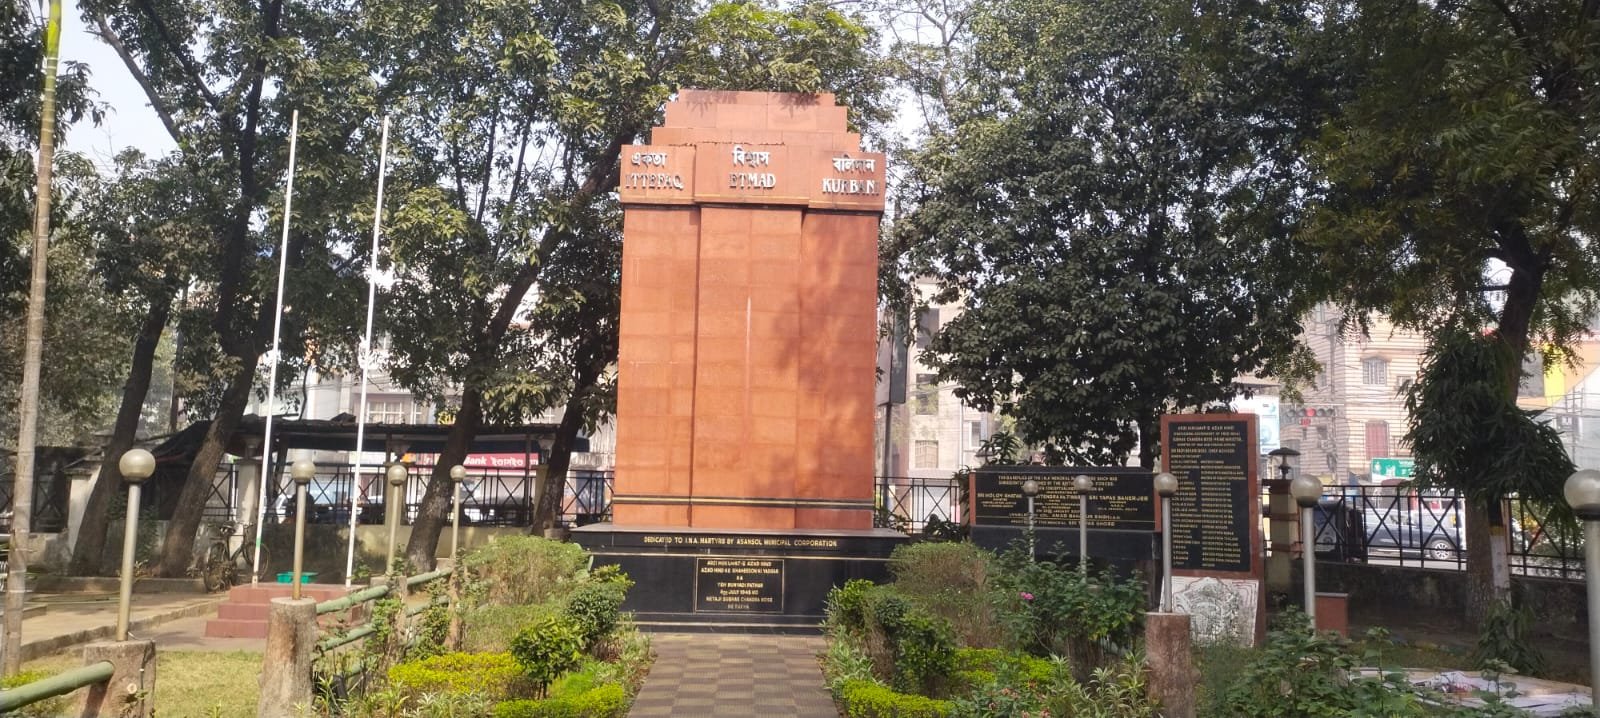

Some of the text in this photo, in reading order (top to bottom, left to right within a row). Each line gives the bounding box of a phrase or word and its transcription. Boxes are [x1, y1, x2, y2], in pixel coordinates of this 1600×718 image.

[631, 152, 667, 168] একতা
[731, 145, 769, 168] বিশ্বাস
[832, 154, 876, 174] বলিদান
[625, 173, 684, 191] ITTEFAQ
[729, 173, 776, 190] ETMAD
[822, 178, 880, 196] KURBANI
